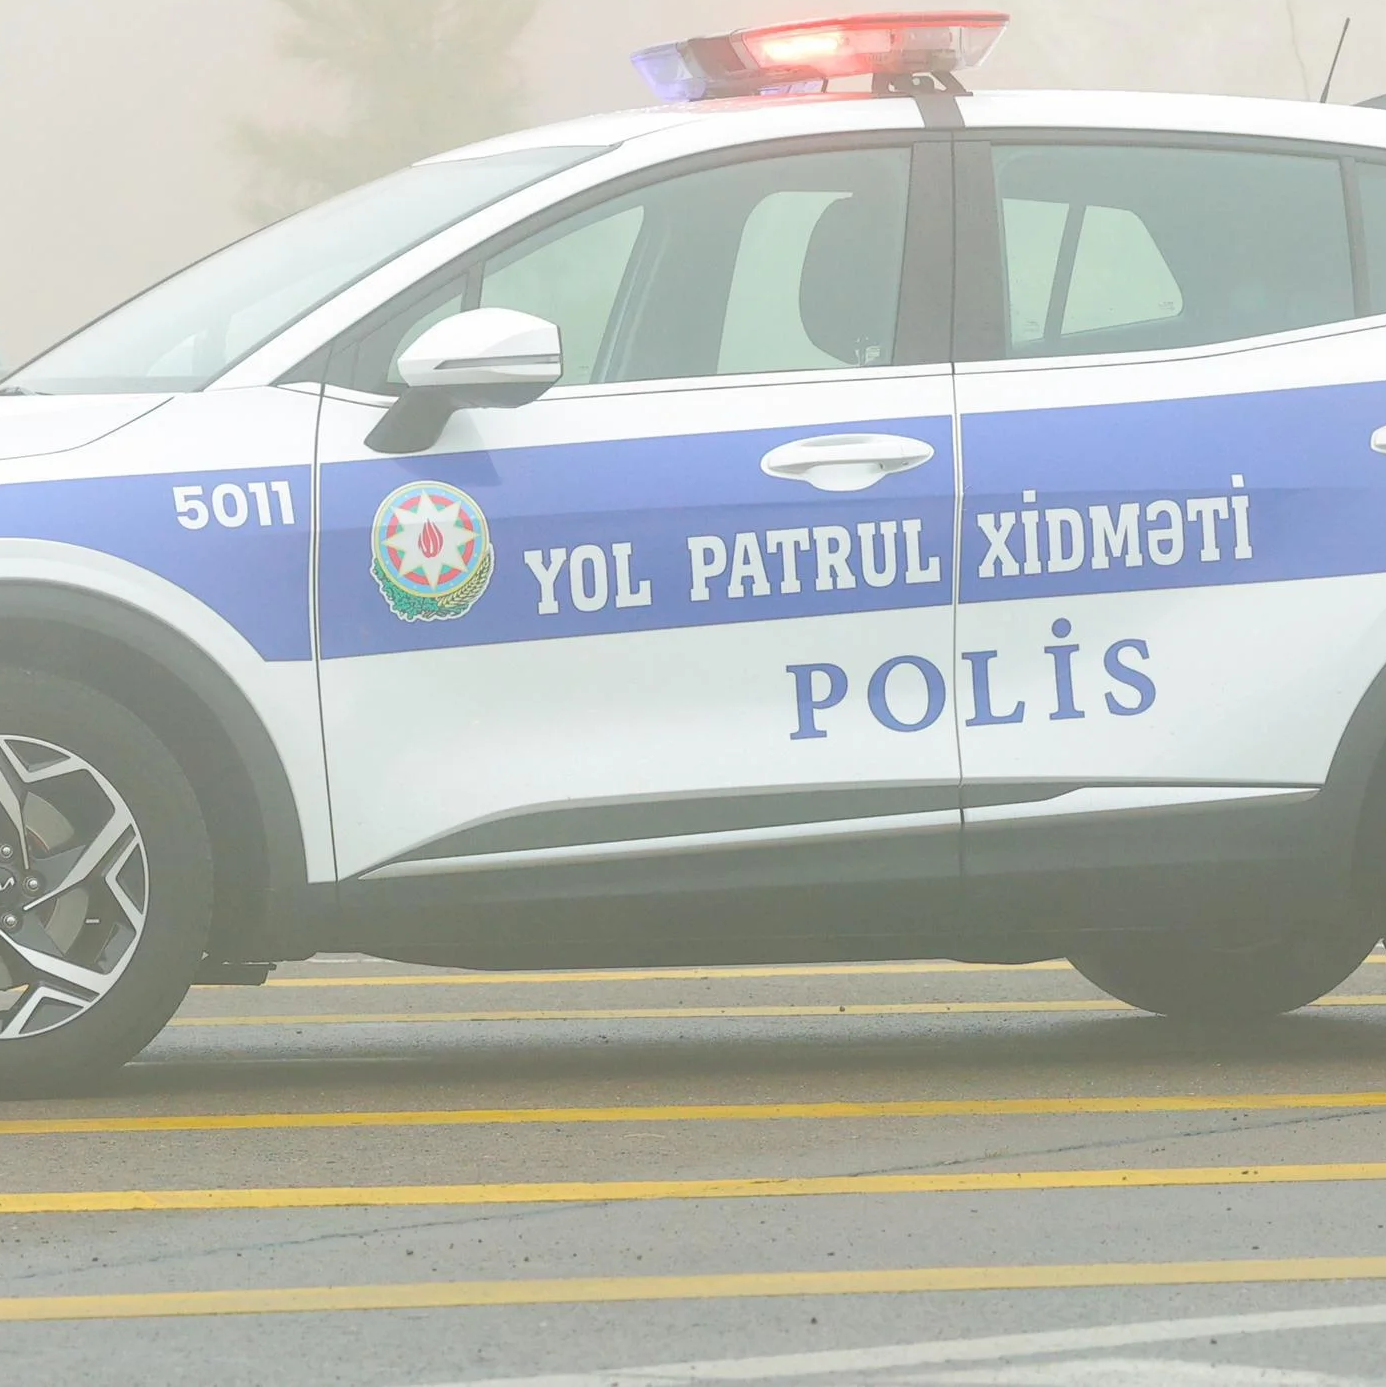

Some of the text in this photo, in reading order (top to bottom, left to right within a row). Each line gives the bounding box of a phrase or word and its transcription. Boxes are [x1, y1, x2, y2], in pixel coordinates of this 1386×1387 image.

[172, 480, 296, 530] 5011
[523, 473, 1253, 615] YOL PATRUL XİDMƏTİ
[785, 616, 1157, 741] POLİS
